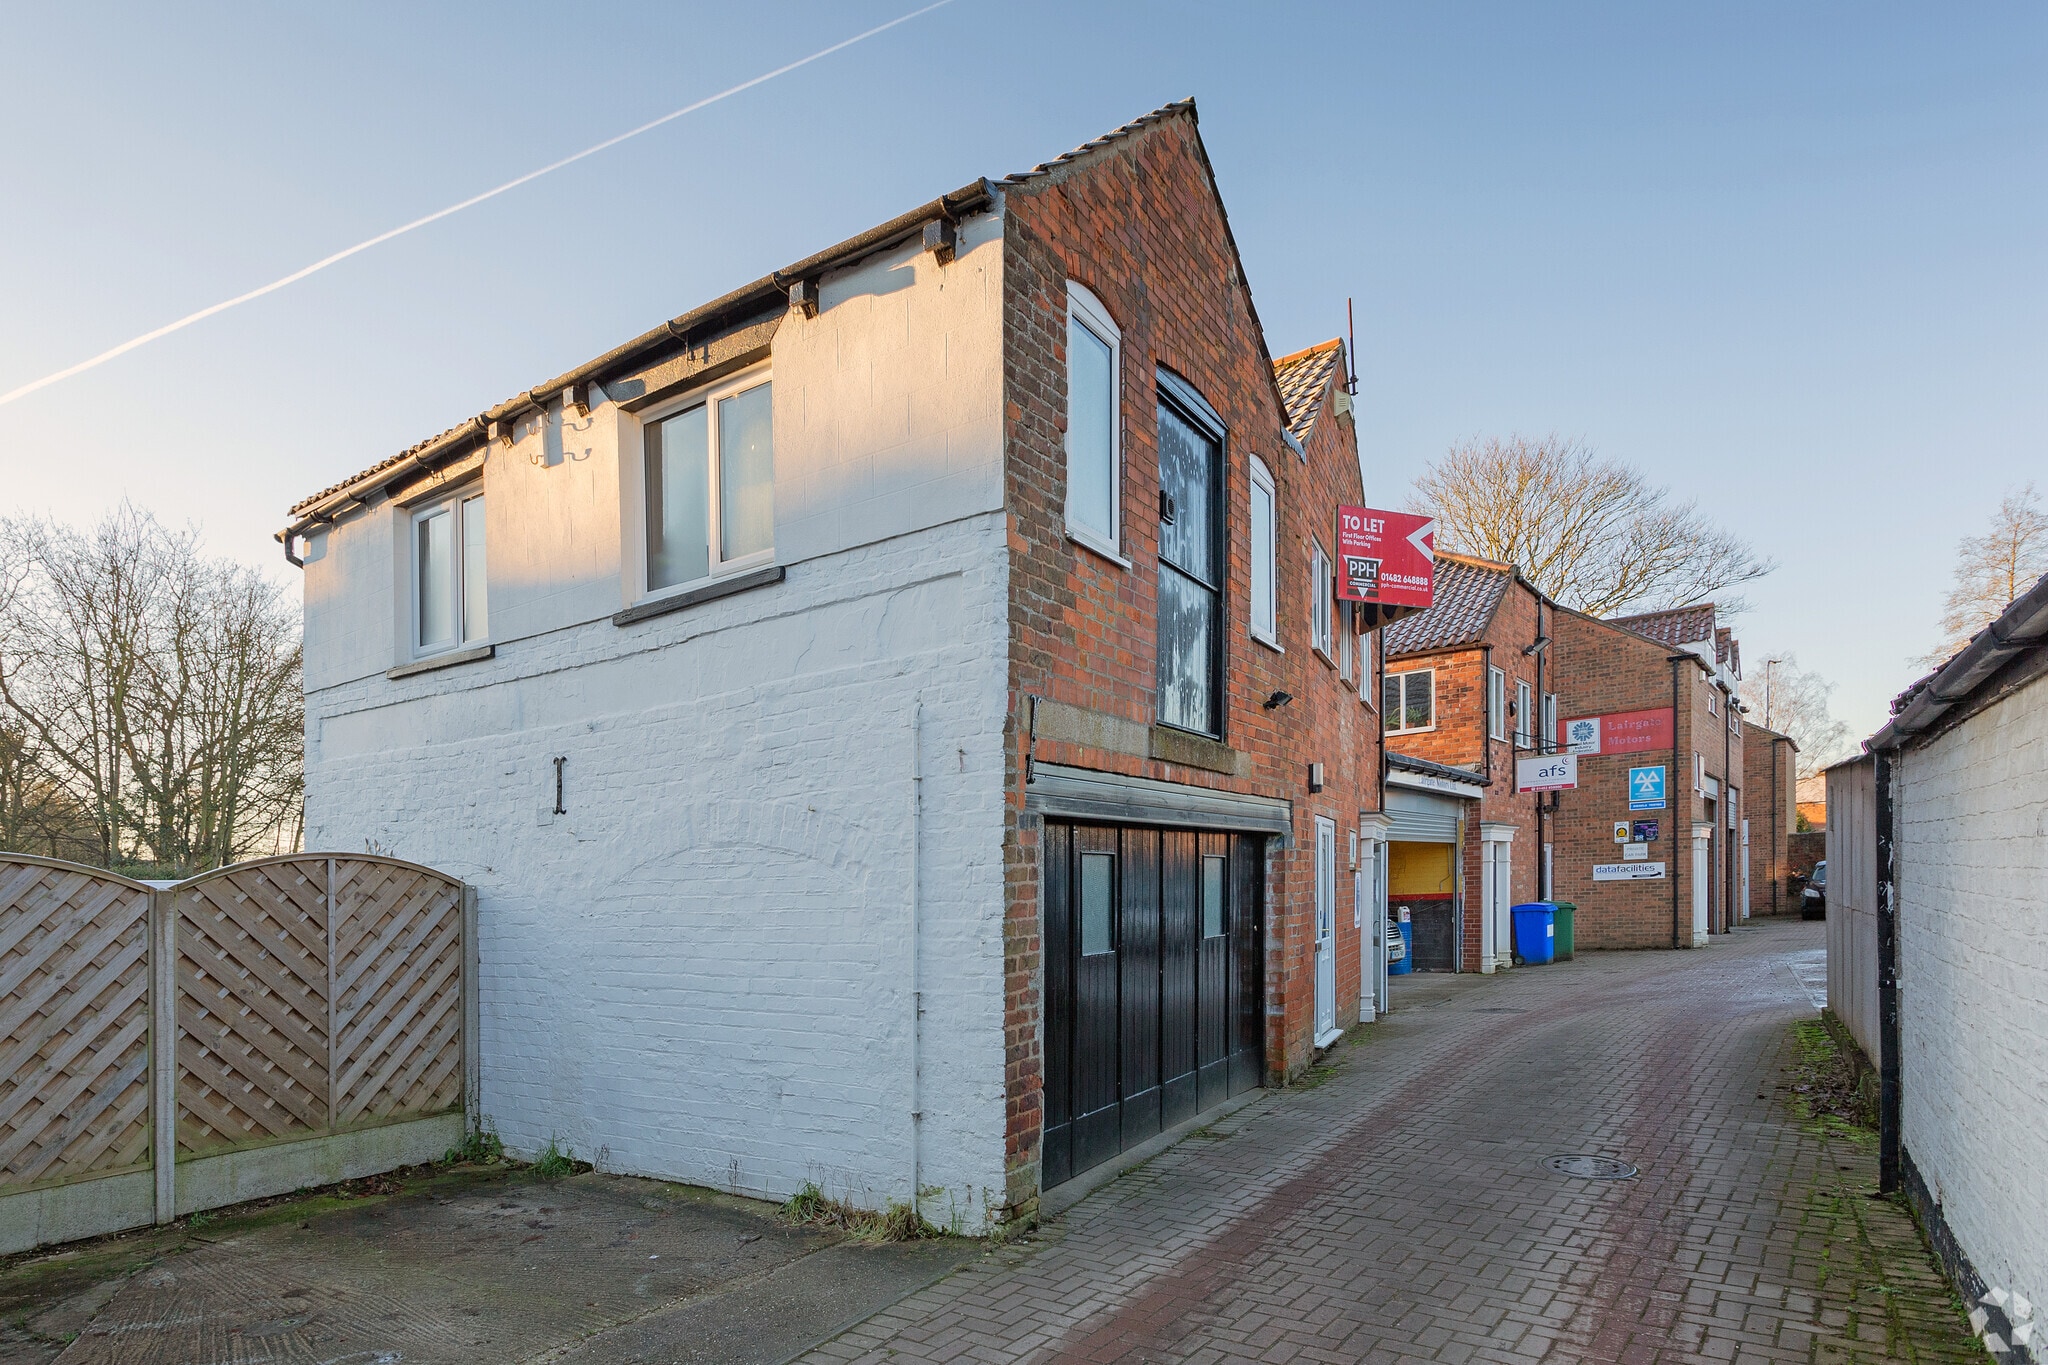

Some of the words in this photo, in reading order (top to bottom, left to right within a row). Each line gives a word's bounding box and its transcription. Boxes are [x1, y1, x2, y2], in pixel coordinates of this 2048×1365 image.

[1342, 515, 1360, 530] TO
[1364, 518, 1385, 533] LET
[1365, 534, 1381, 542] Offices
[1353, 540, 1370, 548] Parking
[1349, 561, 1376, 578] PPH
[1381, 573, 1401, 583] 01482
[1403, 575, 1428, 585] 648888
[1381, 583, 1428, 592] pph-commercial.co.uk
[1608, 719, 1662, 731] Lairgate
[1608, 735, 1652, 745] Motors
[1538, 765, 1566, 777] afs
[1595, 864, 1655, 873] datafacilities
